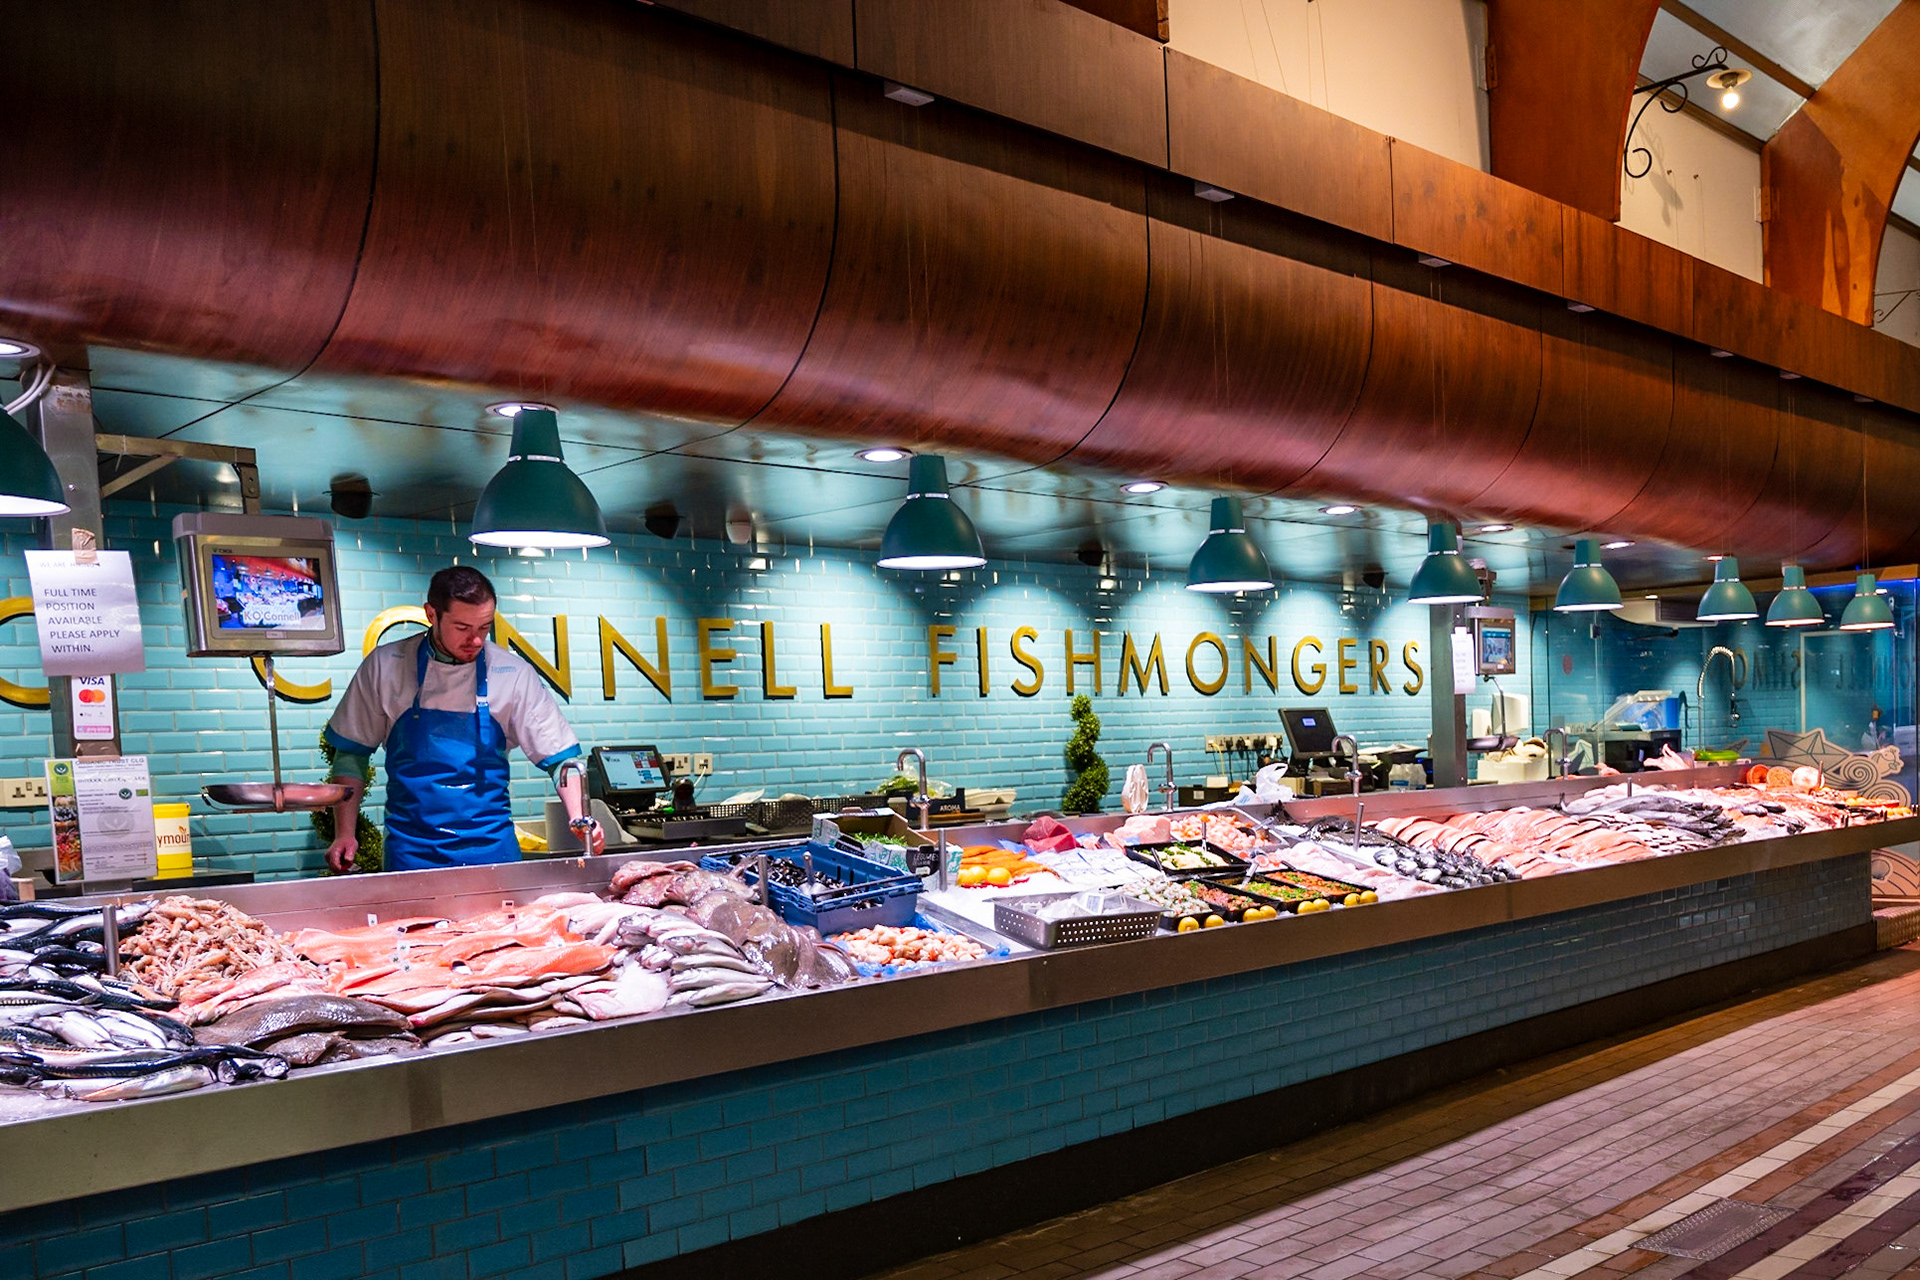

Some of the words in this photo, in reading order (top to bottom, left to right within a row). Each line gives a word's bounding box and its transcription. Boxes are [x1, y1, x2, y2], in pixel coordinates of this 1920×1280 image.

[44, 588, 69, 597] FULL
[71, 588, 97, 597] TIME
[46, 602, 95, 611] POSITION
[48, 616, 102, 625] AVAILABLE
[50, 630, 87, 639] PLEASE
[89, 630, 120, 639] APPLY
[51, 644, 94, 653] WITHIN.
[928, 624, 1424, 698] FISHMONGERS
[80, 676, 105, 685] VISA
